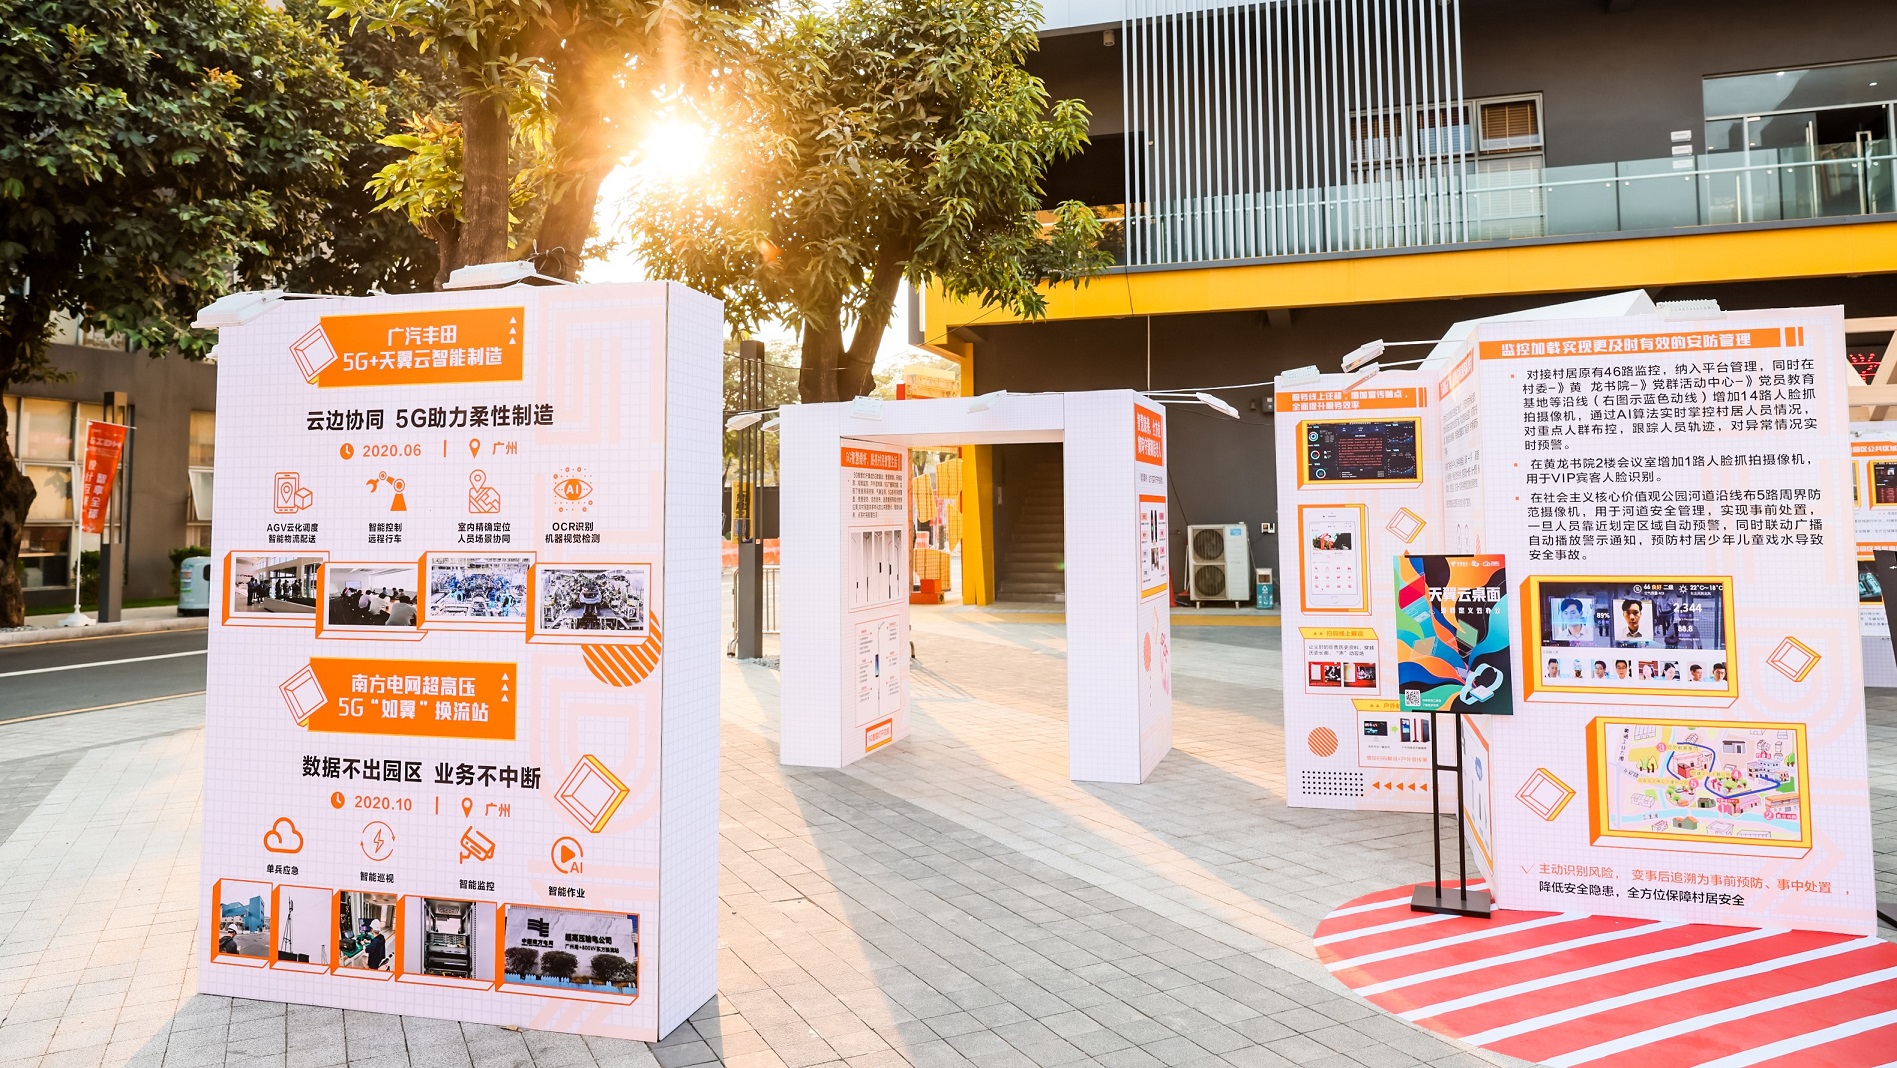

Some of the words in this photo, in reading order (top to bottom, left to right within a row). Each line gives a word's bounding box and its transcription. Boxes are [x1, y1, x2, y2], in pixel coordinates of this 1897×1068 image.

[387, 325, 457, 347] 广汽丰田
[1501, 333, 1751, 357] 监控加载实现更及时有效的安防管理
[343, 347, 503, 371] 5G+天翼云智能制造
[1527, 358, 1814, 381] 对接村居原有46路监控，纳入平台管理，同时在
[1292, 401, 1359, 411] 全面提升服务效率
[306, 409, 385, 432] 云边协同
[396, 404, 554, 428] 5G助力柔性制造
[1524, 417, 1817, 438] 对重点人群布控，跟踪人员轨迹，对异常情况实
[362, 443, 422, 458] 2020.06
[492, 441, 518, 456] 广州
[1525, 438, 1571, 451] 时预警。
[1531, 454, 1812, 471] 在黄龙书院2楼会议室增加1路人脸抓拍摄像机，
[1526, 470, 1663, 485] 用于VIP宾客人脸识别。
[566, 484, 580, 496] AI
[1531, 488, 1821, 505] 在社会主义核心价值观公园河道沿线布5路周界防
[1527, 503, 1814, 519] 范摄像机，用于河道安全管理，实现事前处置，
[267, 522, 319, 533] AGV云化调度
[368, 522, 402, 533] 智能控制
[458, 522, 511, 533] 室内精确定位
[552, 522, 594, 532] OCR识别
[1528, 517, 1823, 534] 一旦人员靠近划定区域自动预警，同时联动广播
[268, 534, 316, 544] 智能物流配送
[368, 534, 402, 544] 远程行车
[457, 534, 511, 544] 人员场景协同
[544, 533, 600, 544] 机器视觉检测
[1529, 533, 1823, 547] 自动播放警示通知，预防村居少年儿童戏水导致
[1529, 549, 1588, 561] 安全事故。
[1429, 587, 1501, 602] 天翼云桌面
[1673, 603, 1702, 613] 2,344
[351, 675, 476, 697] 南方电网超高压
[302, 754, 423, 784] 数据不出园区
[434, 761, 541, 790] 业务不中断
[355, 795, 412, 812] 2020.10
[484, 803, 511, 818] 广州
[266, 863, 299, 876] 单兵应急
[570, 862, 584, 874] AI
[360, 871, 395, 884] 智能巡视
[459, 879, 495, 892] 智能监控
[548, 885, 586, 899] 智能作业
